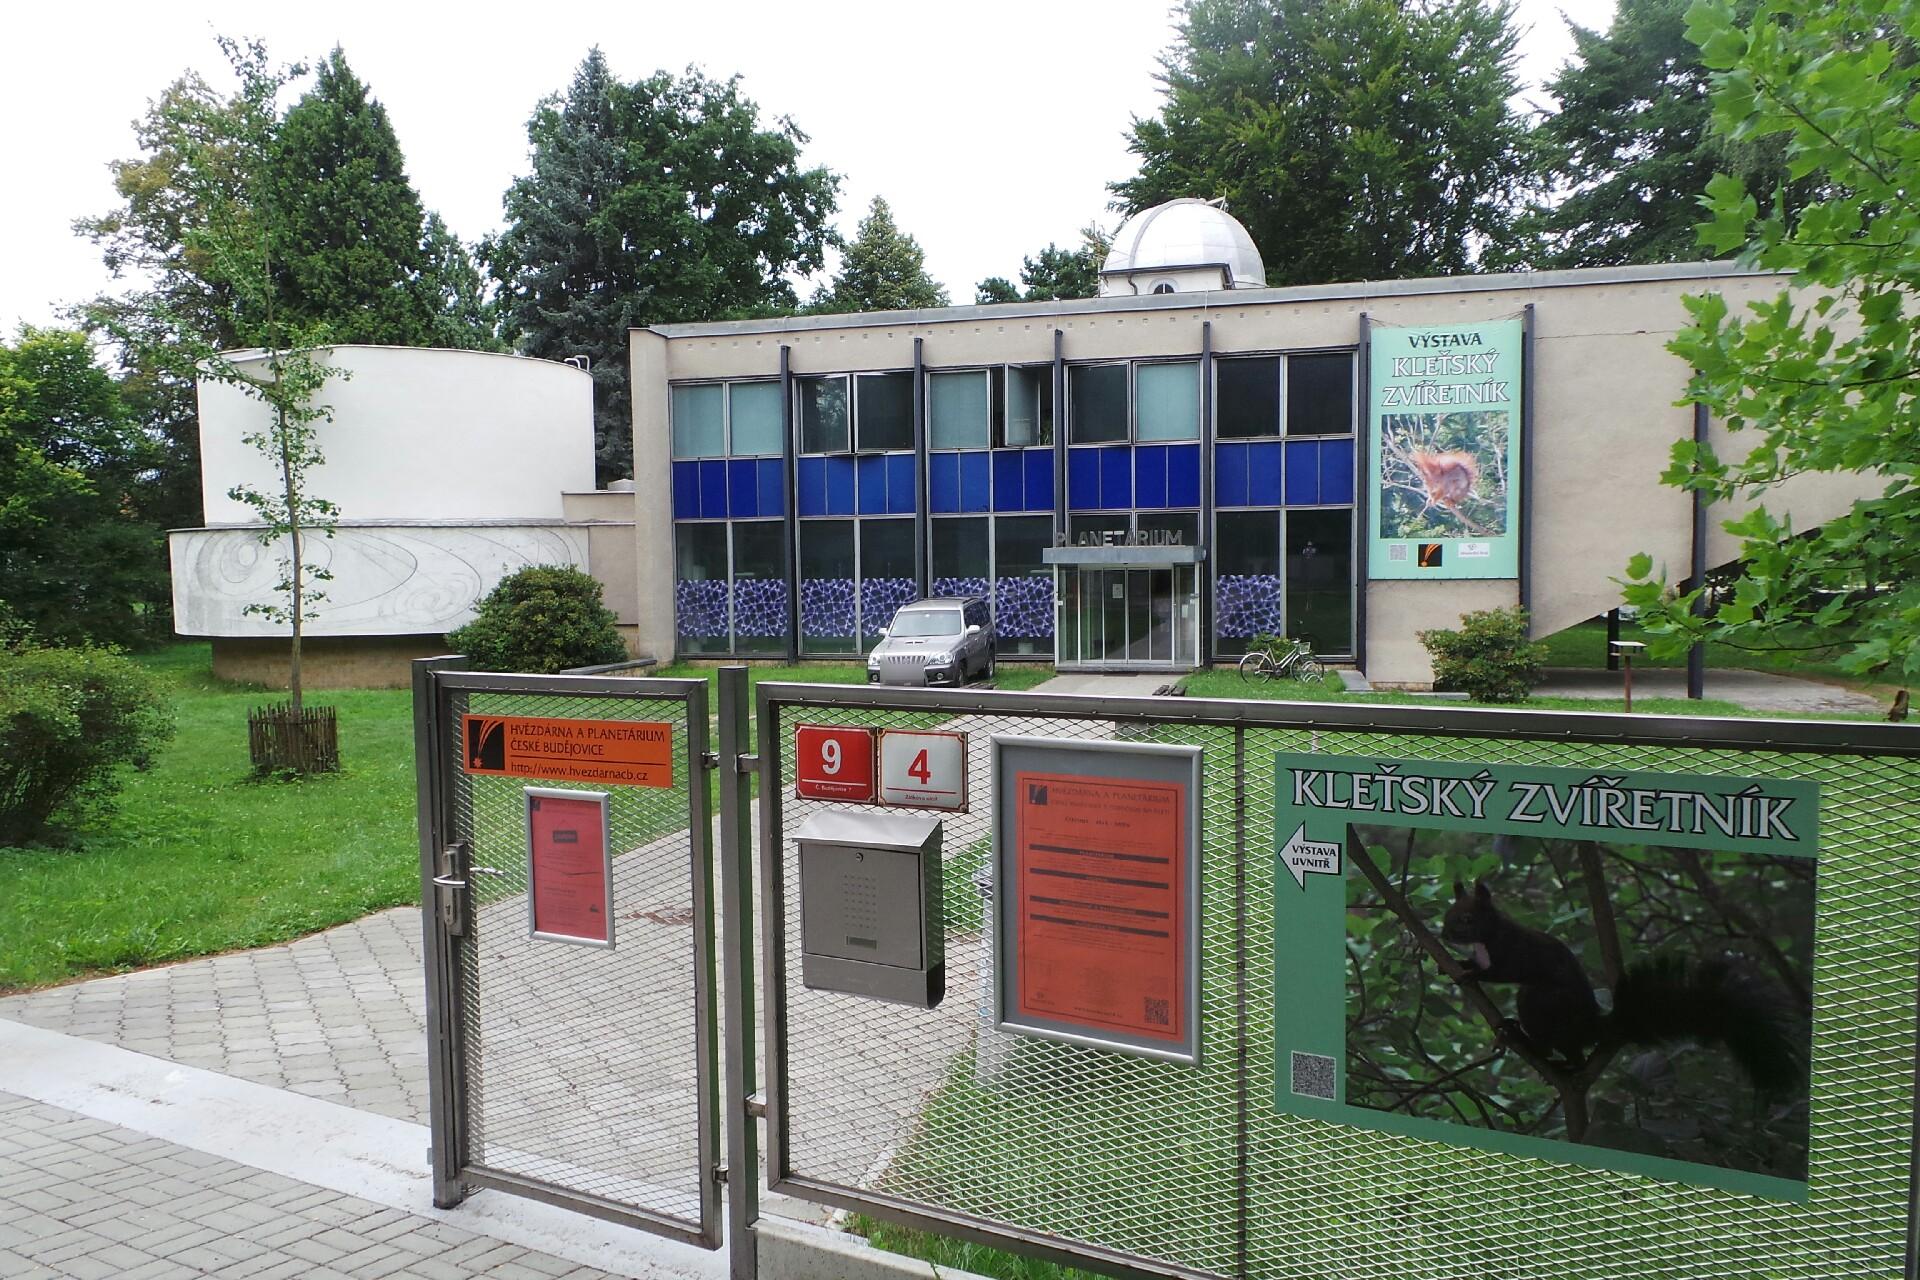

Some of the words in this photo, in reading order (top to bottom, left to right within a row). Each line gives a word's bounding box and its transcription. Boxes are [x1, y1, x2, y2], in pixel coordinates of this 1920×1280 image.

[1410, 332, 1482, 348] VÝSTAVA
[1392, 348, 1500, 377] KLEŤSKÝ
[1381, 378, 1511, 407] ZVÍŘETNÍK
[510, 722, 573, 738] HVĚZDÁRNA
[576, 728, 584, 738] A
[587, 727, 665, 742] PLANETÁRIUM
[510, 737, 541, 752] ČESKÉ
[543, 740, 605, 757] BUDĚJOVICE
[821, 739, 842, 774] 9
[511, 762, 648, 780] http://www.hvezdarnacb.cz
[908, 749, 931, 784] 4
[1287, 763, 1499, 820] KLEŤSKÝ
[1505, 774, 1799, 842] ZVÍŘETNÍK
[1292, 843, 1336, 857] VÝSTAVA
[1292, 857, 1331, 869] UVNITŘ
